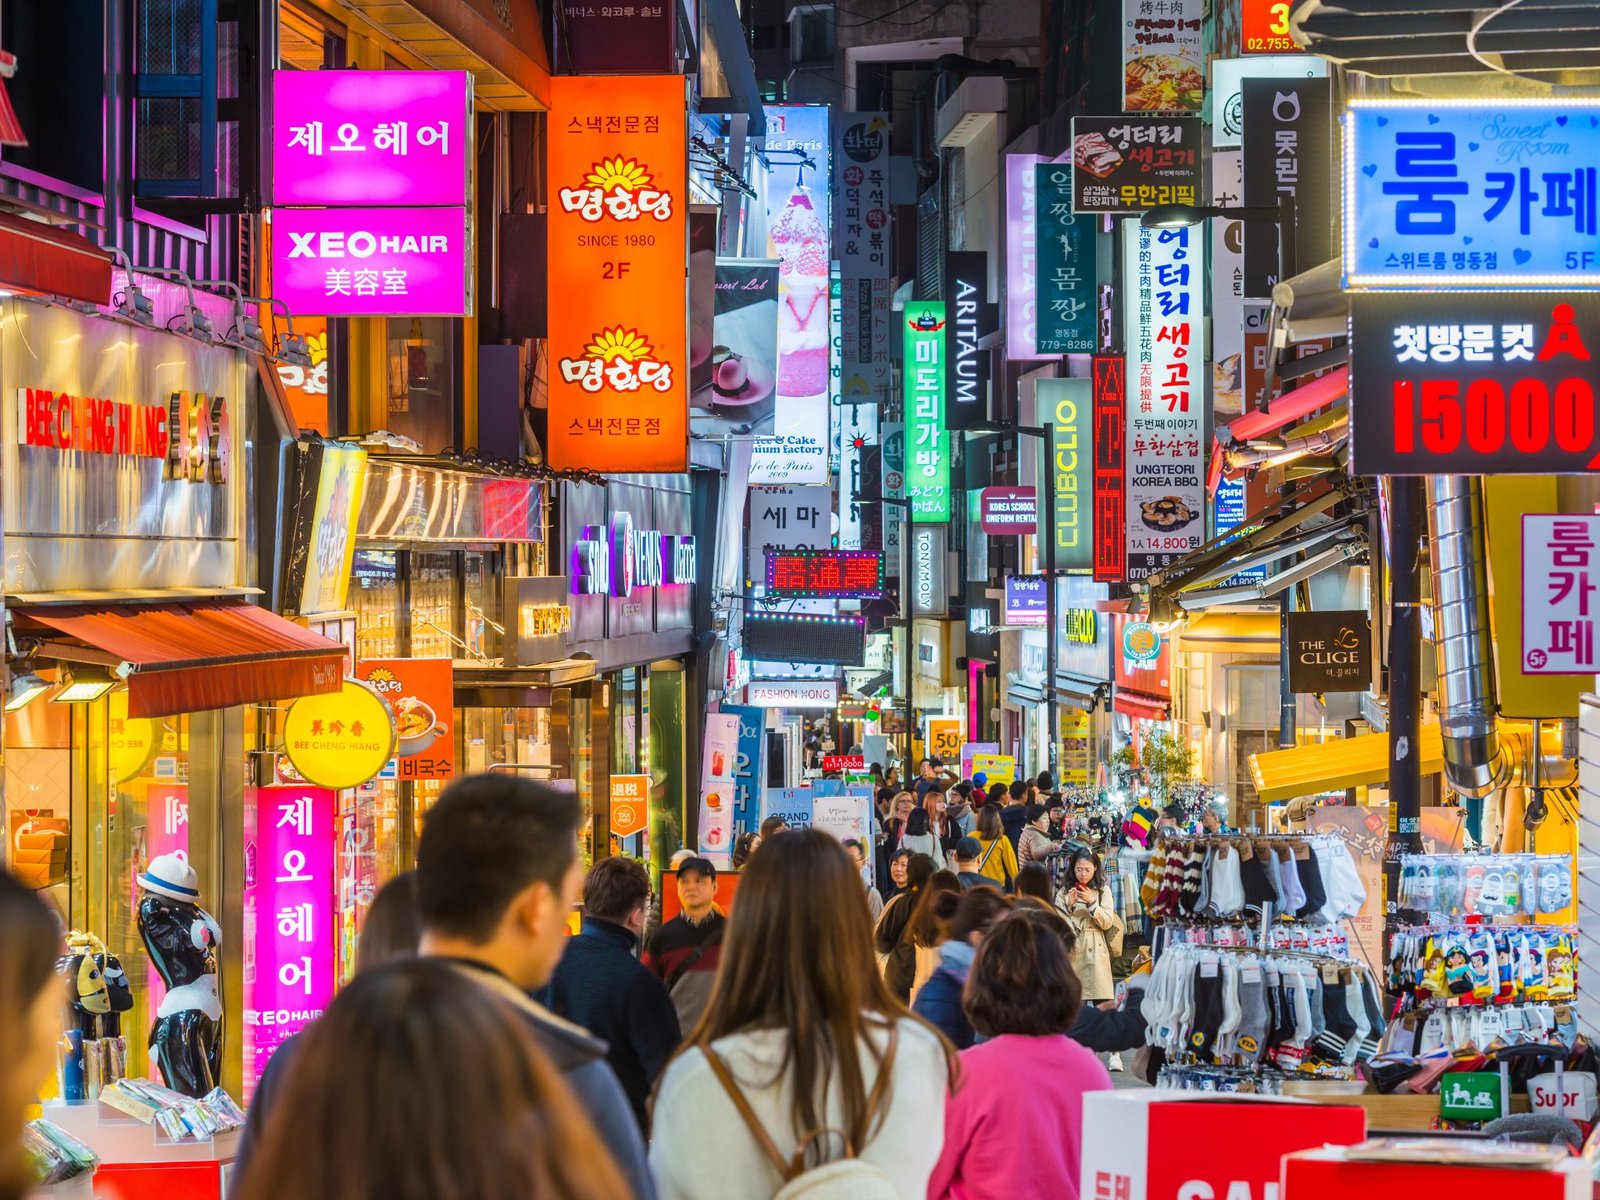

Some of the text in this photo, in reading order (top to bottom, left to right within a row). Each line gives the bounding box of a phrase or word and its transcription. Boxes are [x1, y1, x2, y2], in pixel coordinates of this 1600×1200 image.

[1139, 0, 1184, 15] 烤牛肉
[567, 115, 660, 134] 스낵전문점
[287, 120, 450, 156] 제오헤어
[765, 139, 784, 150] de
[1107, 124, 1183, 150] 엉터리
[1128, 146, 1195, 173] 생고기
[1082, 196, 1118, 206] 된장찌개
[1120, 184, 1195, 206] 무한리필
[559, 187, 673, 222] 명화당
[866, 169, 887, 267] 즉석떡볶이
[287, 230, 449, 259] XEO HAIR
[577, 234, 656, 247] SINCE 1980
[1384, 251, 1498, 270] 스위트룸 명동점
[1565, 251, 1596, 270] 5F
[601, 262, 631, 280] 2F
[325, 268, 409, 297] 美容室
[741, 278, 769, 291] Lab
[955, 279, 977, 402] ARITAUM
[1055, 328, 1079, 338] 명동점
[1041, 340, 1094, 350] 779-8286
[1393, 324, 1536, 364] 첫방문 컷
[559, 358, 673, 393] 명화당
[915, 339, 940, 477] 미도리가방
[1393, 377, 1594, 454] 15000
[26, 387, 54, 448] BEE
[57, 392, 115, 455] CHENG
[118, 402, 168, 460] HIANG
[567, 417, 661, 436] 스낵전문점
[1133, 418, 1198, 430] 두번째 이야기
[787, 435, 816, 445] Cake
[1132, 438, 1199, 458] 무한삼겹
[782, 444, 824, 455] factory
[782, 459, 813, 471] Paris
[1135, 464, 1195, 475] UNGTEORI
[768, 471, 789, 479] 2009
[1132, 477, 1199, 488] KOREA BBQ
[910, 485, 944, 497] みどり
[912, 501, 945, 513] かばん
[989, 502, 1036, 512] KOREA SCHOOL
[985, 513, 1015, 523] UNIFORM
[633, 529, 662, 587] VENUS
[919, 533, 931, 608] TONYMOLY
[1299, 640, 1326, 651] THE
[1300, 651, 1360, 665] CLIGE
[754, 689, 830, 699] FASHION HONG
[294, 740, 381, 751] BEE CHENG HIANG
[398, 759, 452, 777] 비국수
[275, 796, 316, 996] 제오헤어
